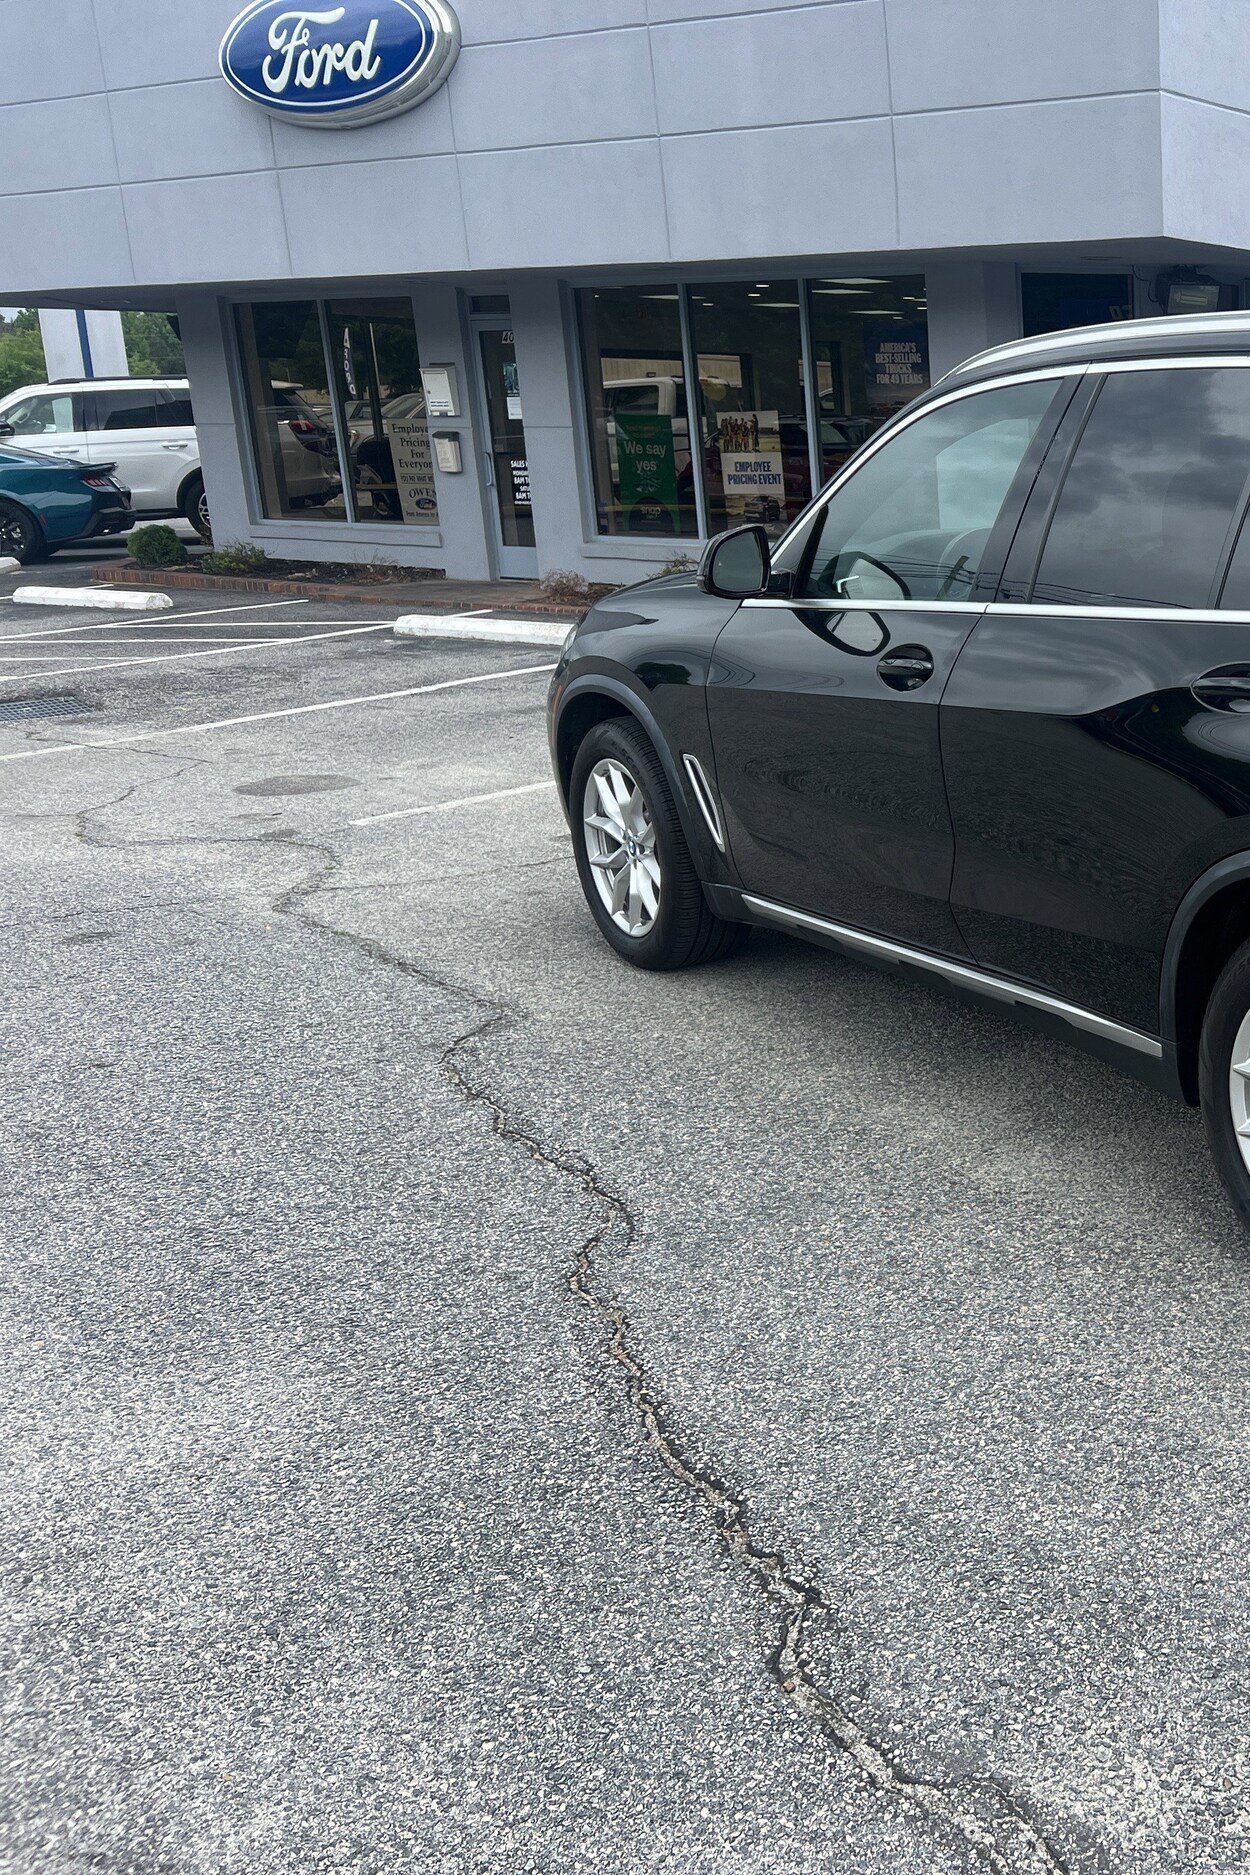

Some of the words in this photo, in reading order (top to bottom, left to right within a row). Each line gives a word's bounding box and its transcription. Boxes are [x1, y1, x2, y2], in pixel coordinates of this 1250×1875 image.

[262, 6, 381, 93] Ford
[880, 343, 917, 353] AMERICA'S
[875, 353, 921, 363] BEST-SELLING
[885, 363, 912, 374] TRUCKS
[876, 374, 890, 384] FOR
[900, 374, 923, 384] YEARS
[410, 449, 424, 458] For
[623, 441, 643, 455] We
[645, 444, 667, 458] say
[636, 460, 657, 474] yes
[734, 461, 772, 472] EMPLOYEE
[727, 473, 757, 485] PRICING
[758, 473, 781, 485] EVENT
